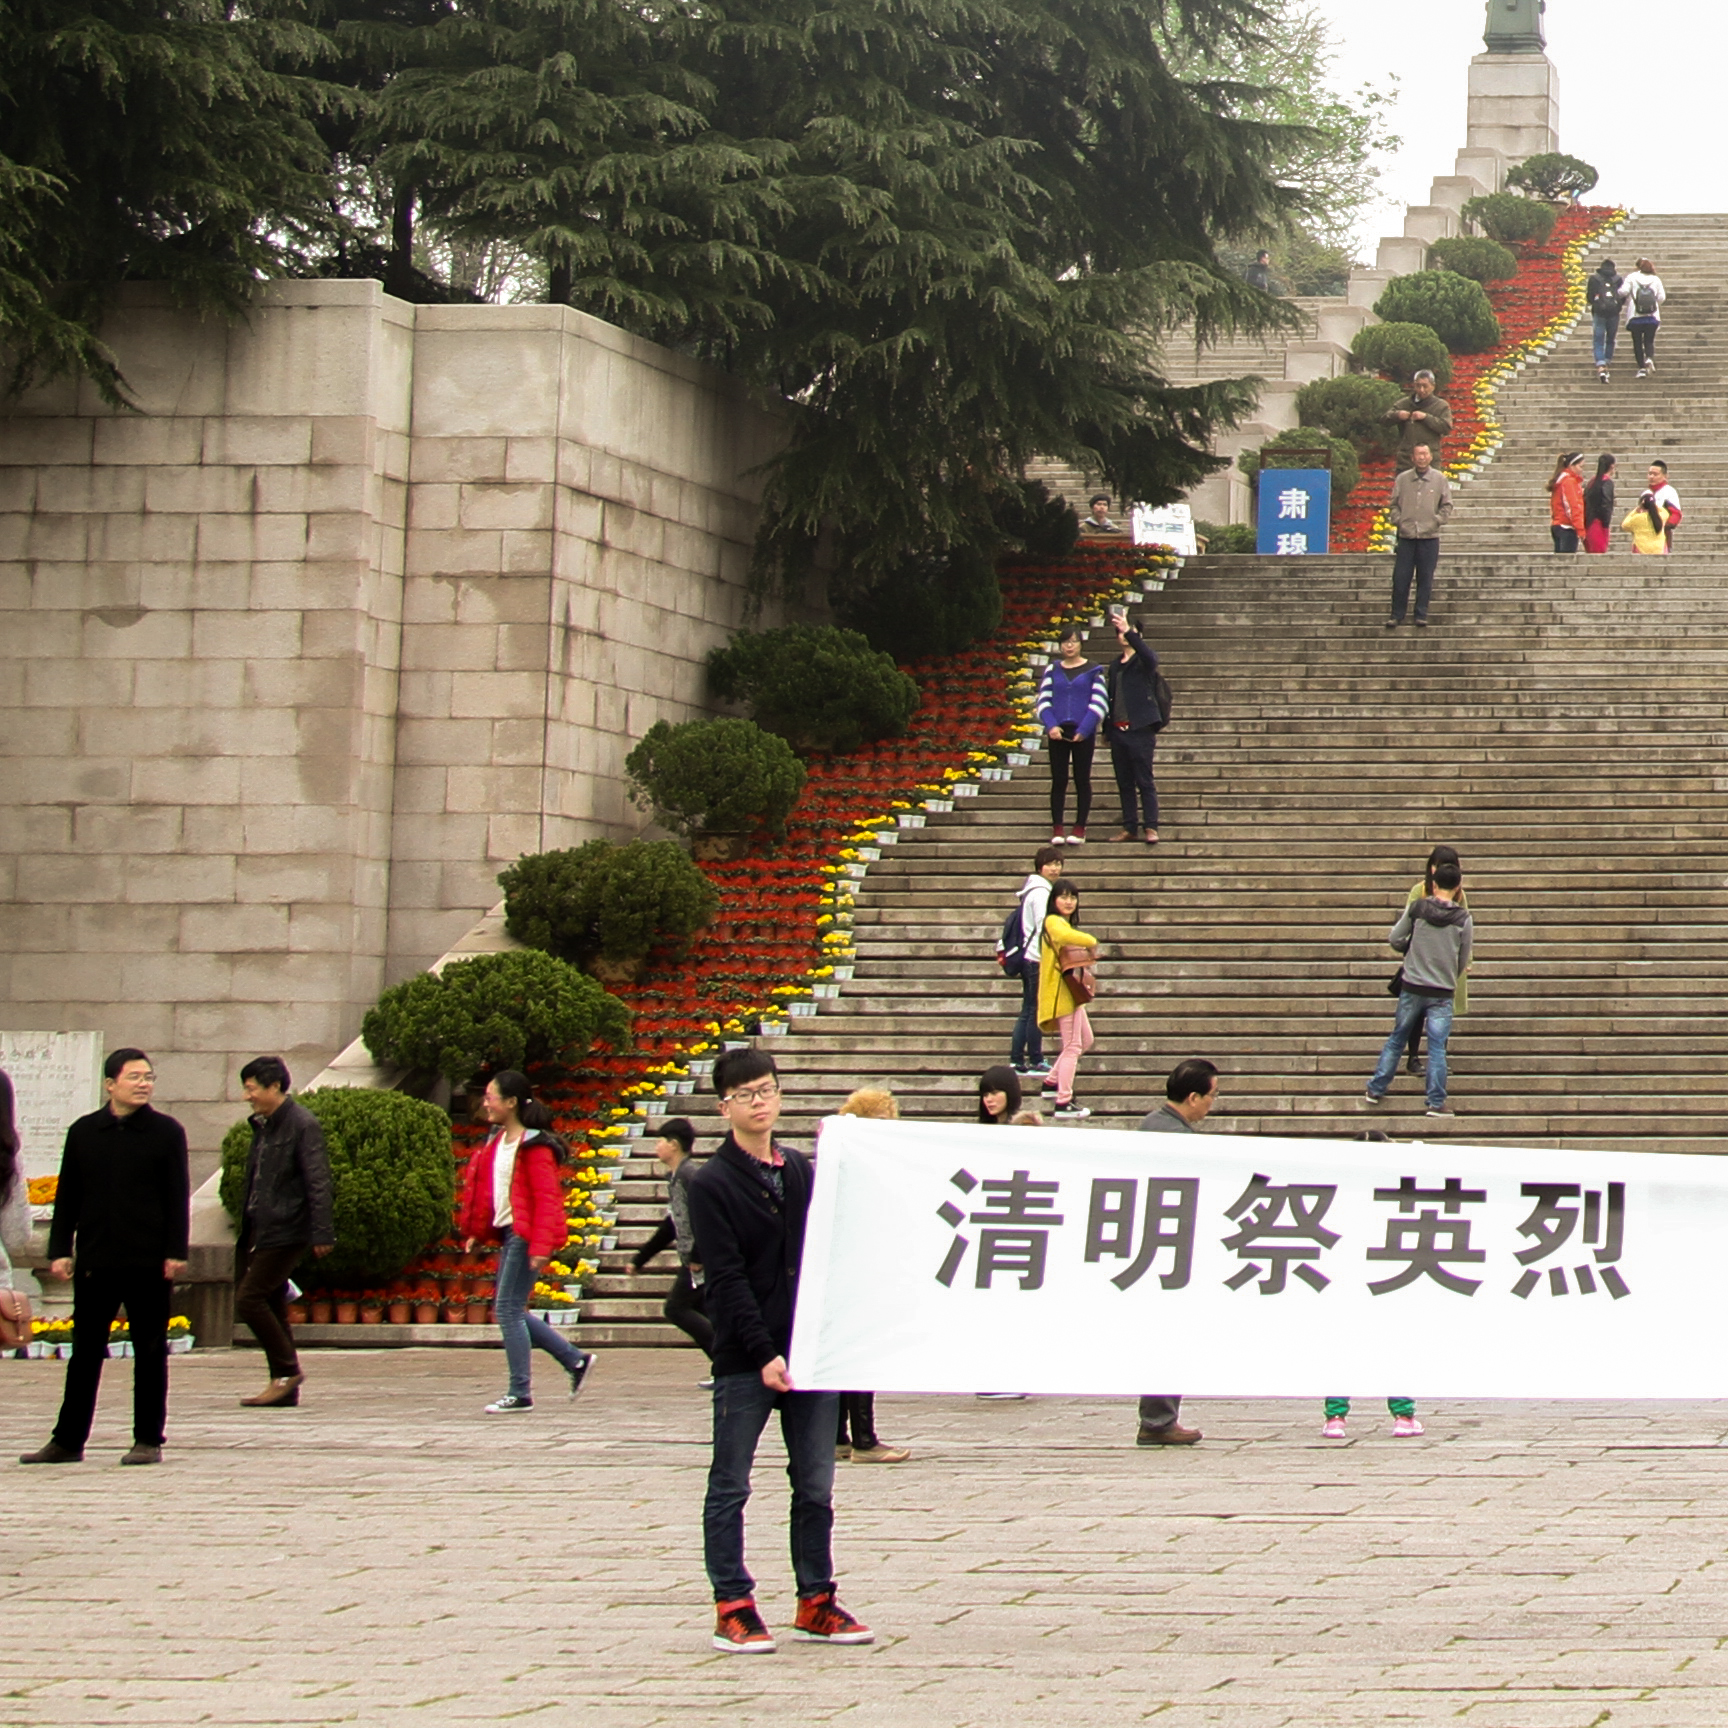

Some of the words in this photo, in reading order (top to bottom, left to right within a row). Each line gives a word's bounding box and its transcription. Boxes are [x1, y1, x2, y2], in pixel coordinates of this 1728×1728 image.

[1276, 487, 1310, 555] 肃穆
[936, 1169, 1631, 1300] 清明祭英烈
